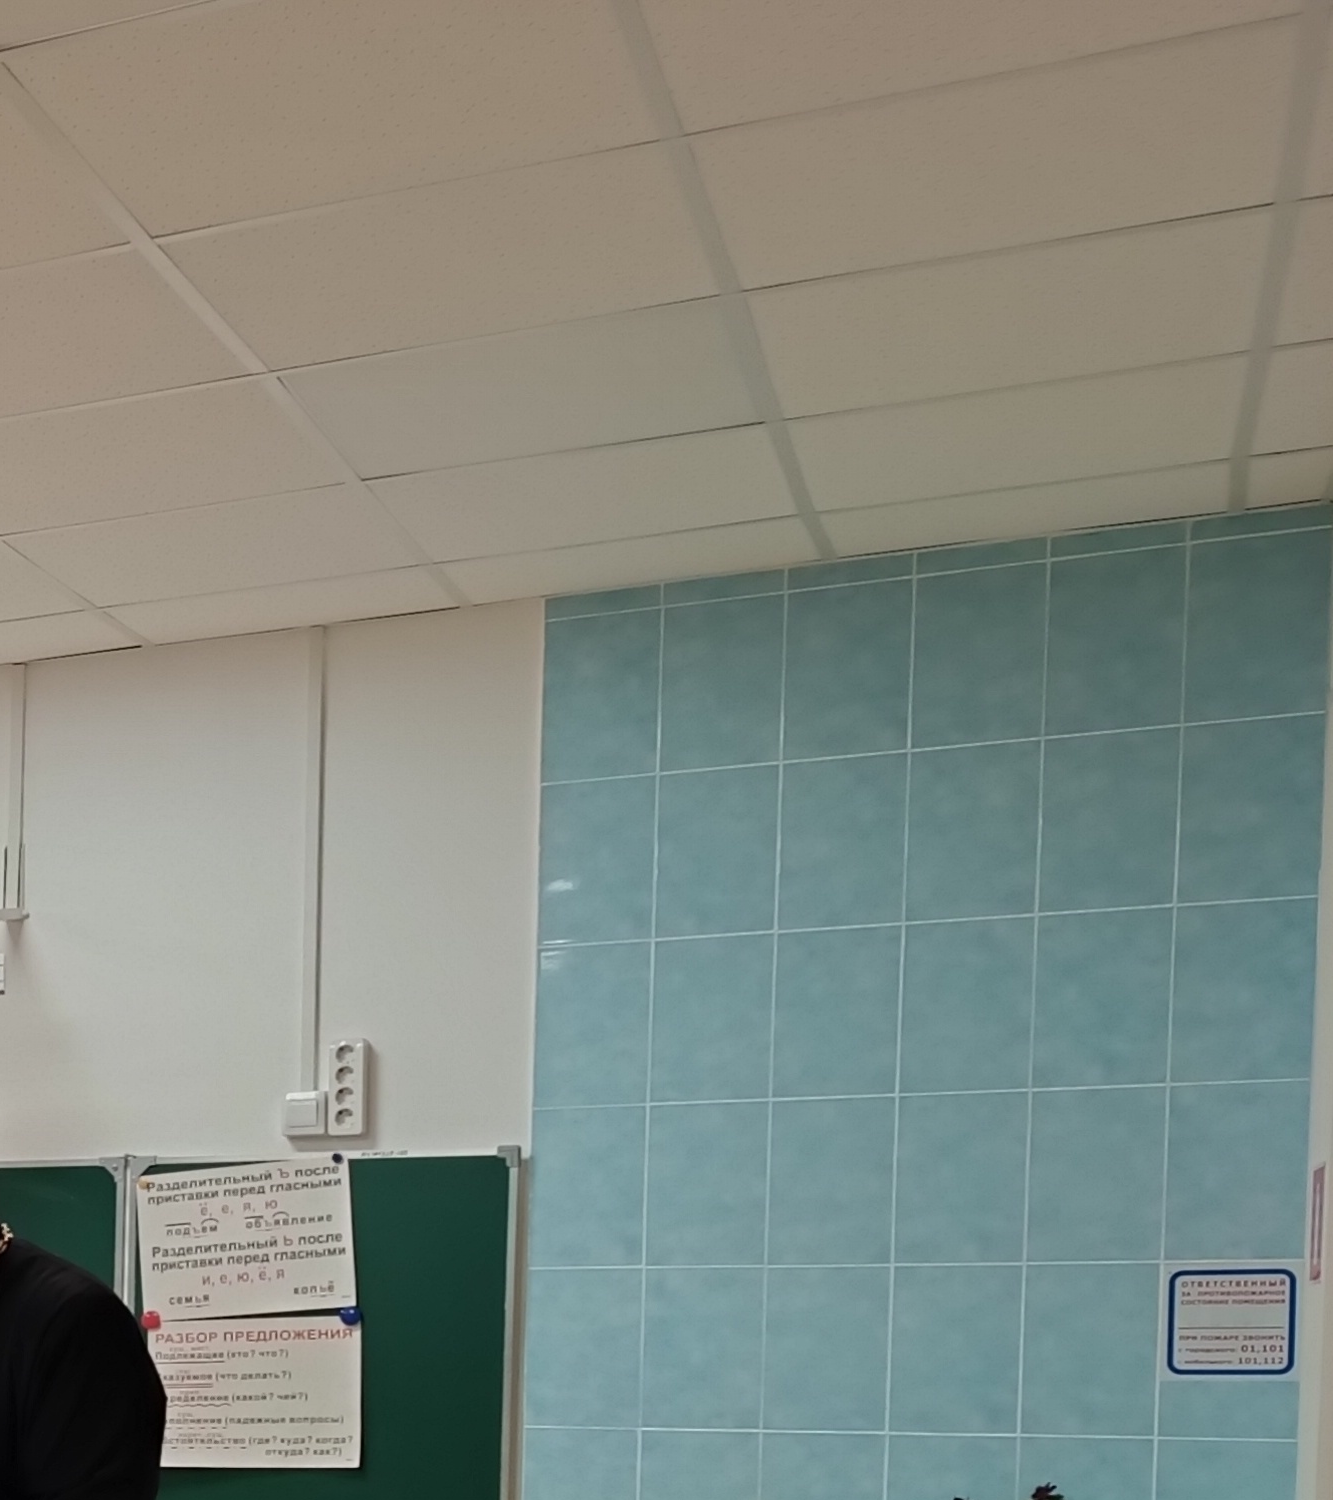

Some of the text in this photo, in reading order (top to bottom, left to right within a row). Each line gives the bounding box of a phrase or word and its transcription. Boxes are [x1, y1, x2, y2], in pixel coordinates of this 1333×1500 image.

[147, 1170, 272, 1192] Разделительный
[294, 1165, 339, 1178] после
[147, 1177, 342, 1206] приставки перед гласными
[245, 1213, 333, 1229] объявление
[152, 1236, 278, 1258] Разделительный
[298, 1232, 343, 1246] после
[152, 1246, 347, 1273] приставки перед гласными
[1181, 1279, 1286, 1288] ОТВЕТСТВЕННЫЙ
[169, 1294, 210, 1306] семья
[155, 1328, 354, 1344] РАЗБОР ПРЕДЛОЖЕНИЯ
[1241, 1344, 1284, 1355] 01,101
[1238, 1357, 1284, 1366] 101,112
[162, 1373, 213, 1382] казуемое
[169, 1394, 229, 1403] ределение
[166, 1417, 222, 1425] полнение
